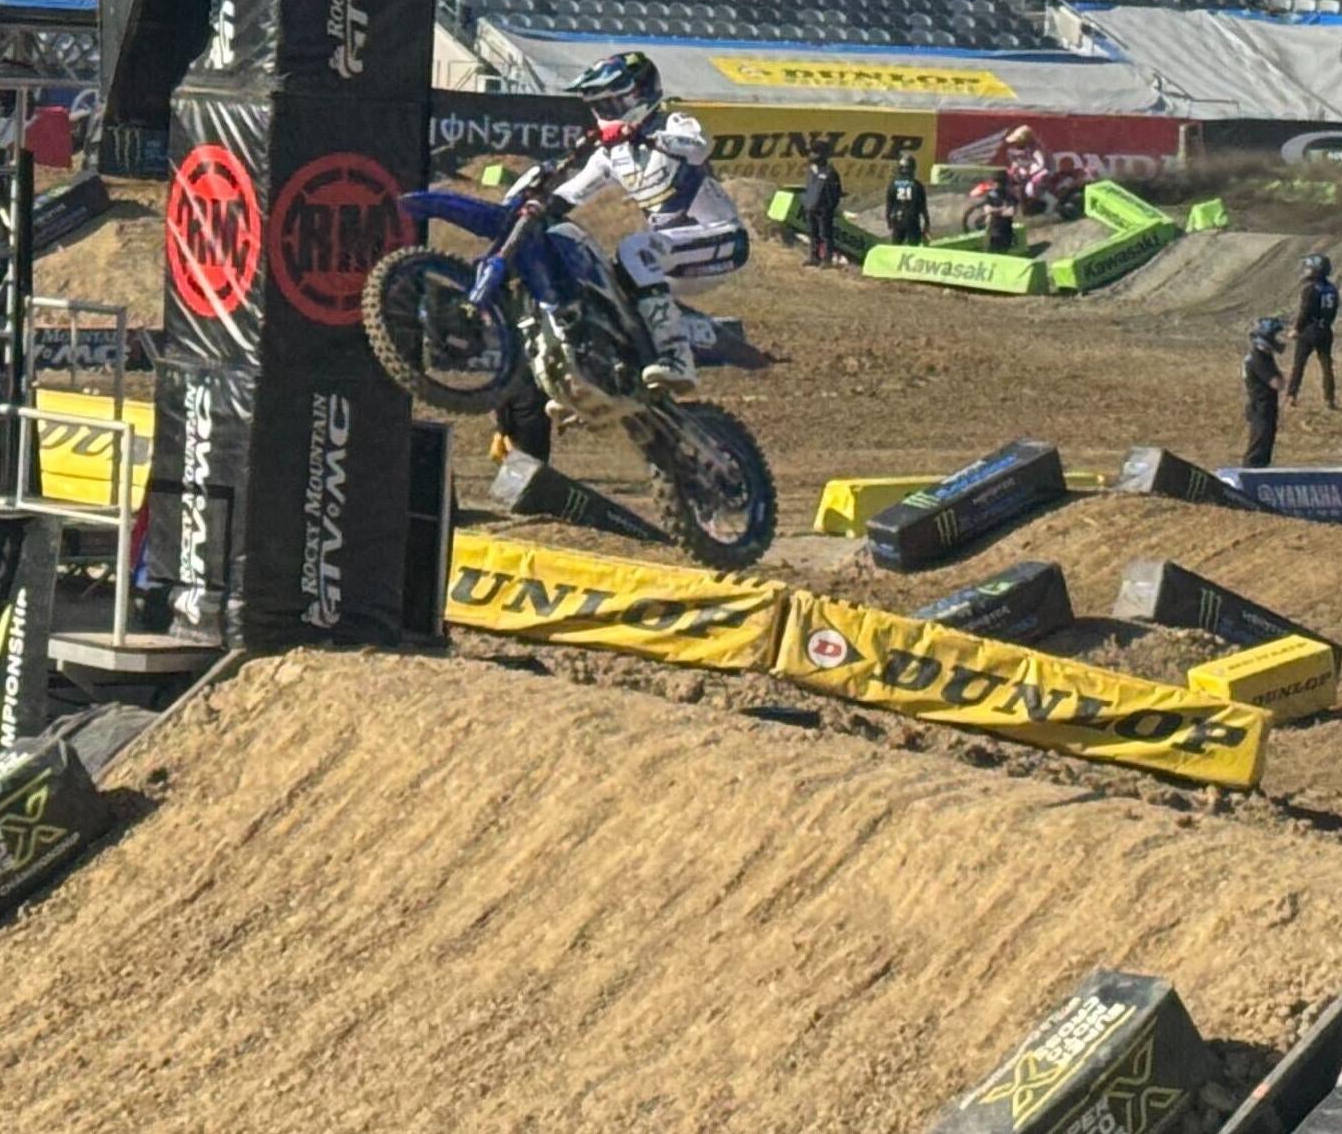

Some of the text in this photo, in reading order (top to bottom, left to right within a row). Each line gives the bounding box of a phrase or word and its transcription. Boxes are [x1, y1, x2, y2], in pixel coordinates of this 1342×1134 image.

[709, 130, 923, 162] DUNLOP
[894, 250, 995, 282] Kawasaki
[179, 380, 199, 582] ROCKY MOUNTAIN
[300, 392, 329, 596] ROCKY MOUNTAIN
[1272, 484, 1342, 509] YAMAHA
[450, 564, 749, 636] UNLOP
[0, 586, 28, 748] MPIONSHIP
[873, 645, 1249, 756] DUNLOP
[1252, 670, 1333, 708] DUNLOP
